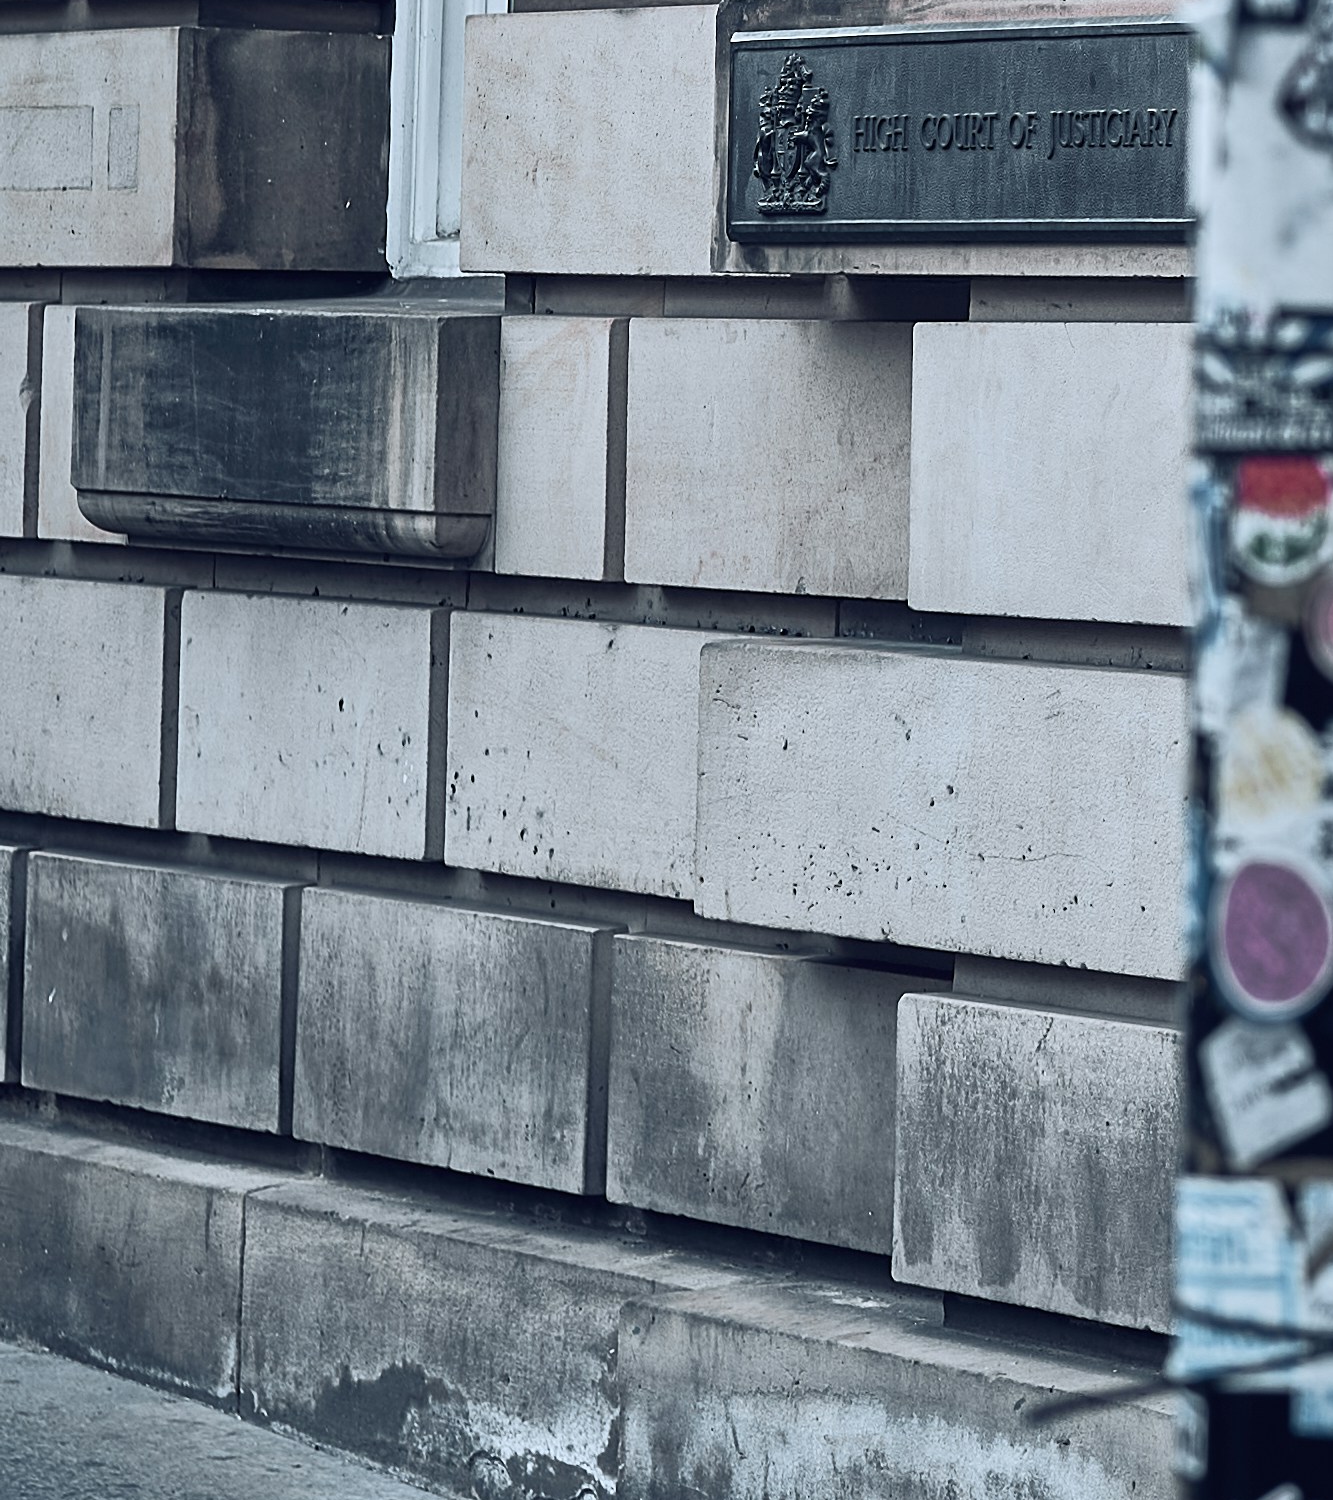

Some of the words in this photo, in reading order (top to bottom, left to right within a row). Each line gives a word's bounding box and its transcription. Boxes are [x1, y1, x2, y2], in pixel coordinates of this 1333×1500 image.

[852, 113, 909, 151] HIGH
[918, 111, 998, 151] COURT
[1007, 110, 1038, 150] OF
[1046, 107, 1178, 161] JUSTICIARY
